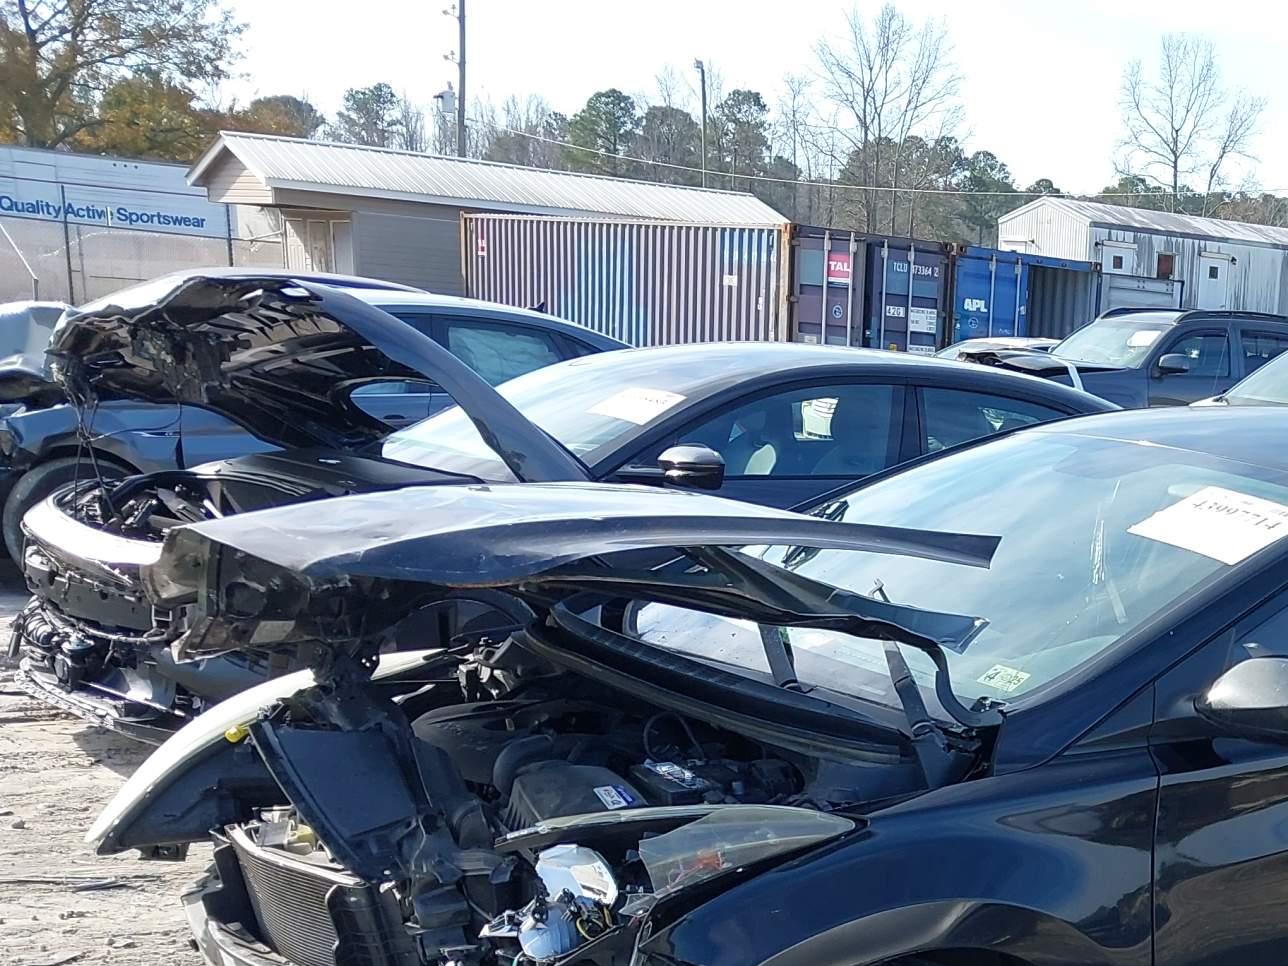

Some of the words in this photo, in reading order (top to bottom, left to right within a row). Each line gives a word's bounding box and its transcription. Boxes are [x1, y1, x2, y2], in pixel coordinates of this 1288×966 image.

[0, 195, 62, 218] Quality
[116, 208, 207, 229] Sportswear
[828, 261, 852, 273] TAL
[963, 298, 988, 312] APL
